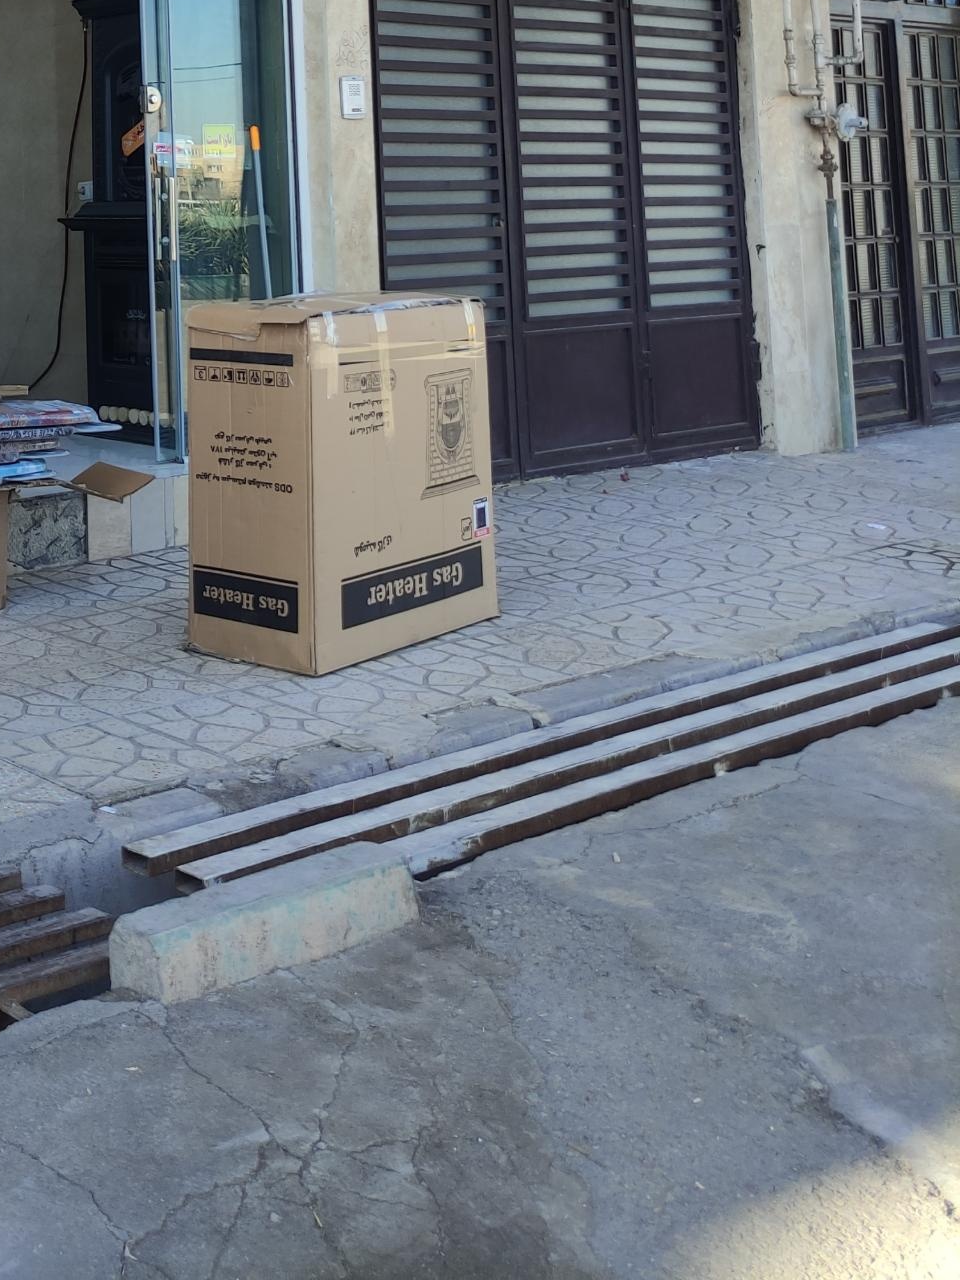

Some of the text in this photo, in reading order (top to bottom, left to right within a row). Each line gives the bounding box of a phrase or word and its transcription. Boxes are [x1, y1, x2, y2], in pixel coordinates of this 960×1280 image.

[267, 451, 278, 461] آب
[220, 475, 247, 485] سیستم
[247, 478, 273, 489] هوشمند
[274, 482, 293, 494] ODS
[353, 534, 392, 558] شومینه گازی
[367, 561, 463, 606] Gas Heater
[202, 585, 289, 617] Gas Heater
